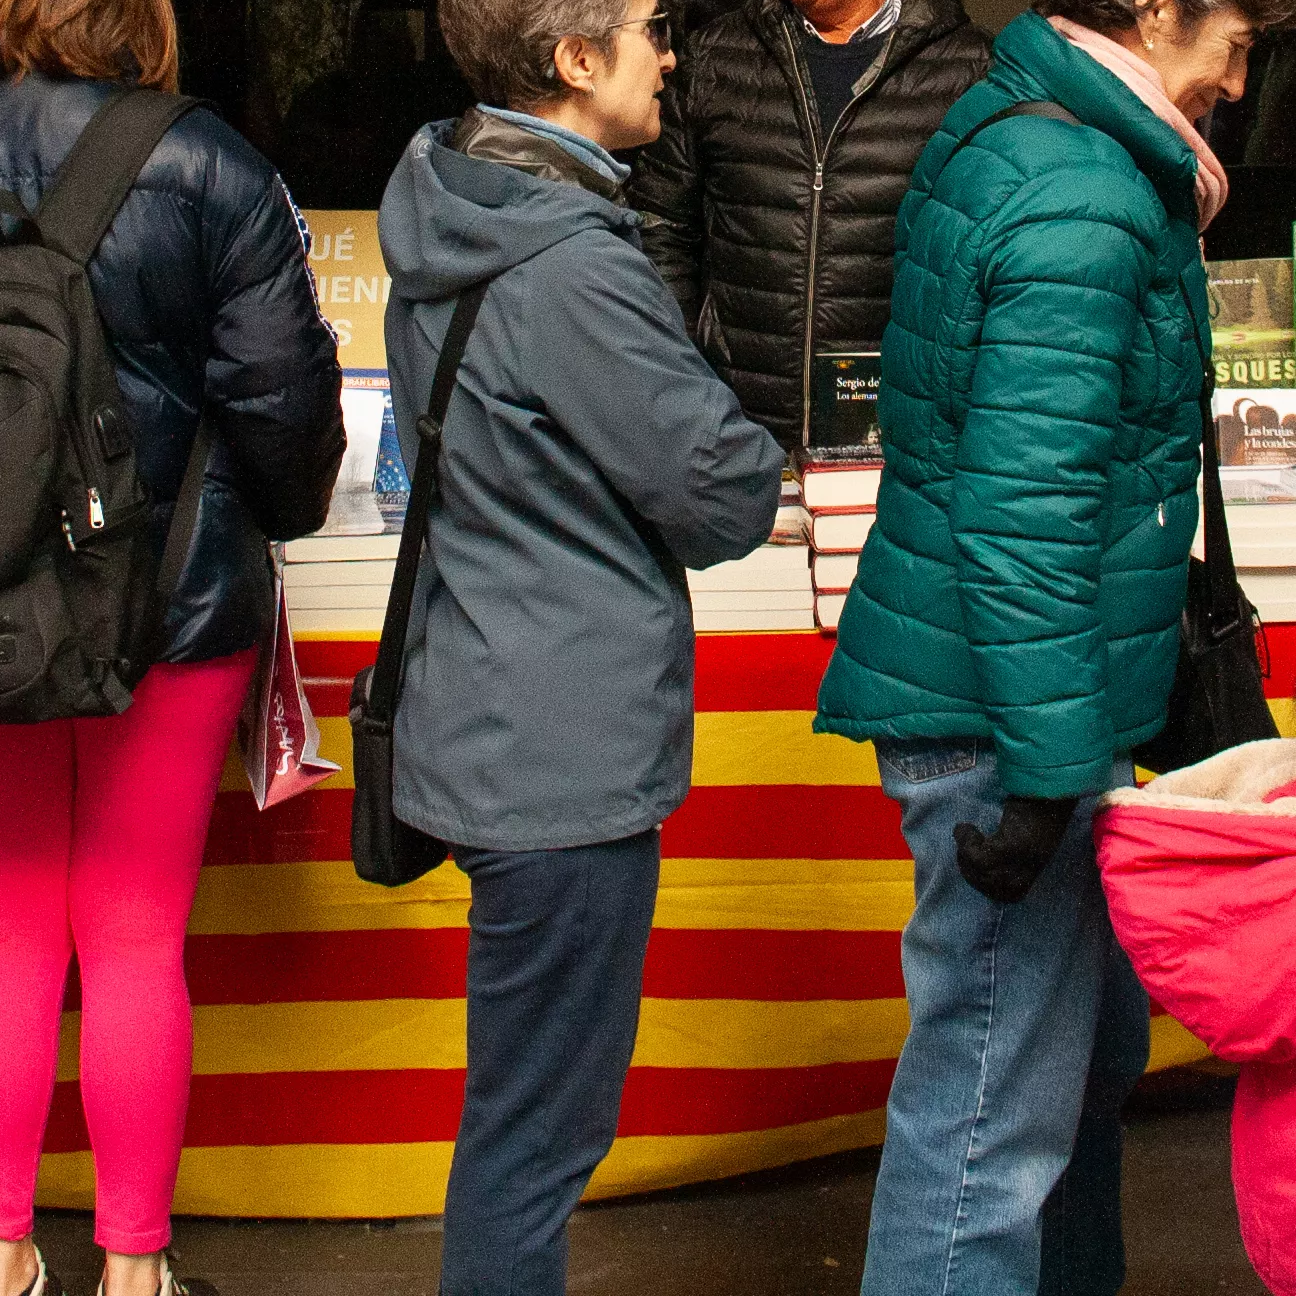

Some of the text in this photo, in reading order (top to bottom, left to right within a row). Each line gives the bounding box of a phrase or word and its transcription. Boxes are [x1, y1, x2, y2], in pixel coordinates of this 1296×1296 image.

[836, 377, 866, 391] Sergio
[836, 391, 850, 400] Los
[1244, 425, 1295, 438] Las brujas
[1245, 439, 1252, 449] y
[1252, 438, 1261, 448] la
